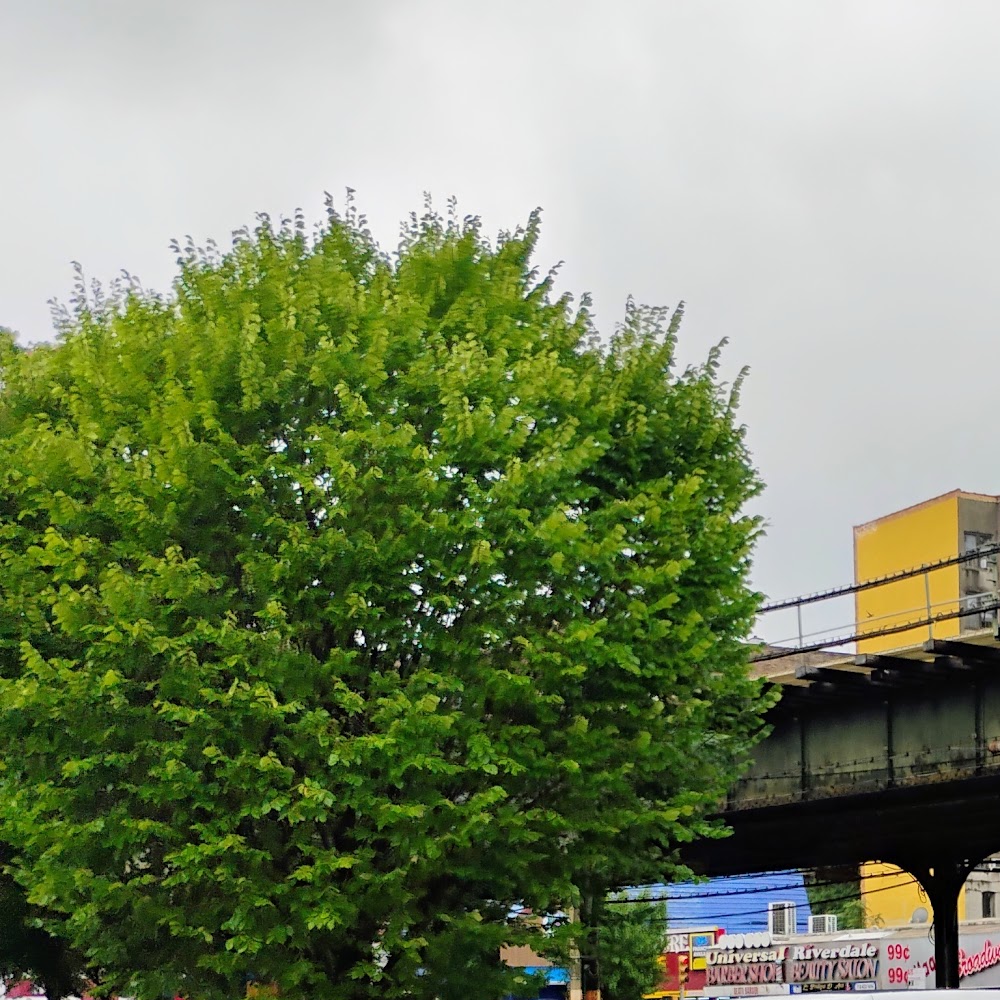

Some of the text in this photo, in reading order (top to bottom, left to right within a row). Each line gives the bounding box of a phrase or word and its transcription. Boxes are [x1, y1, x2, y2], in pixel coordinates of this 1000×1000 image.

[706, 946, 787, 965] Universal
[793, 943, 877, 960] Riverdale
[793, 960, 836, 982] BEAUTY
